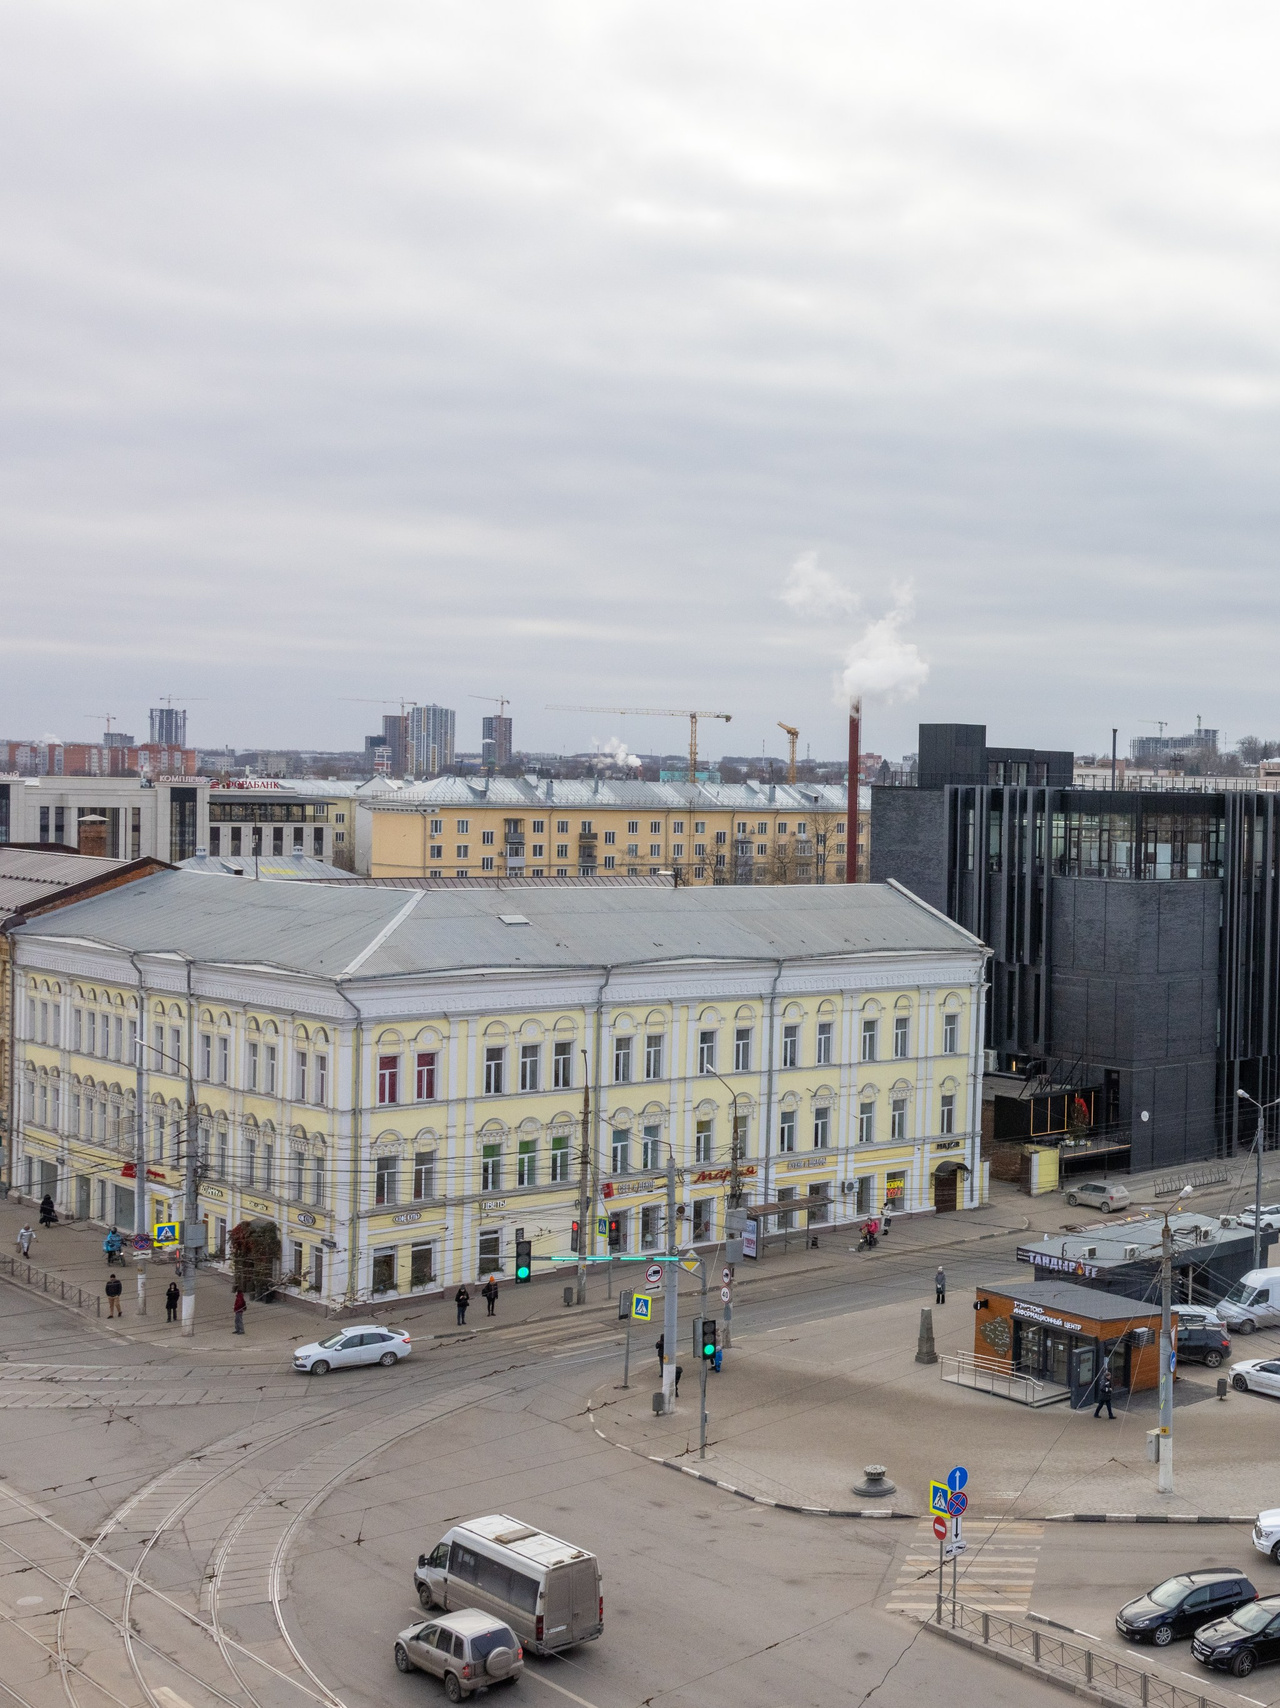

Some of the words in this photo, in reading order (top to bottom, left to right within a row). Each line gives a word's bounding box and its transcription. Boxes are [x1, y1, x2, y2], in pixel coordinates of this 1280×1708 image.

[482, 1200, 507, 1209] ЦВЕТЫ
[1013, 1308, 1063, 1327] ИНФОРМАЦИОННЫЙ
[1064, 1321, 1082, 1331] ЦЕНТР
